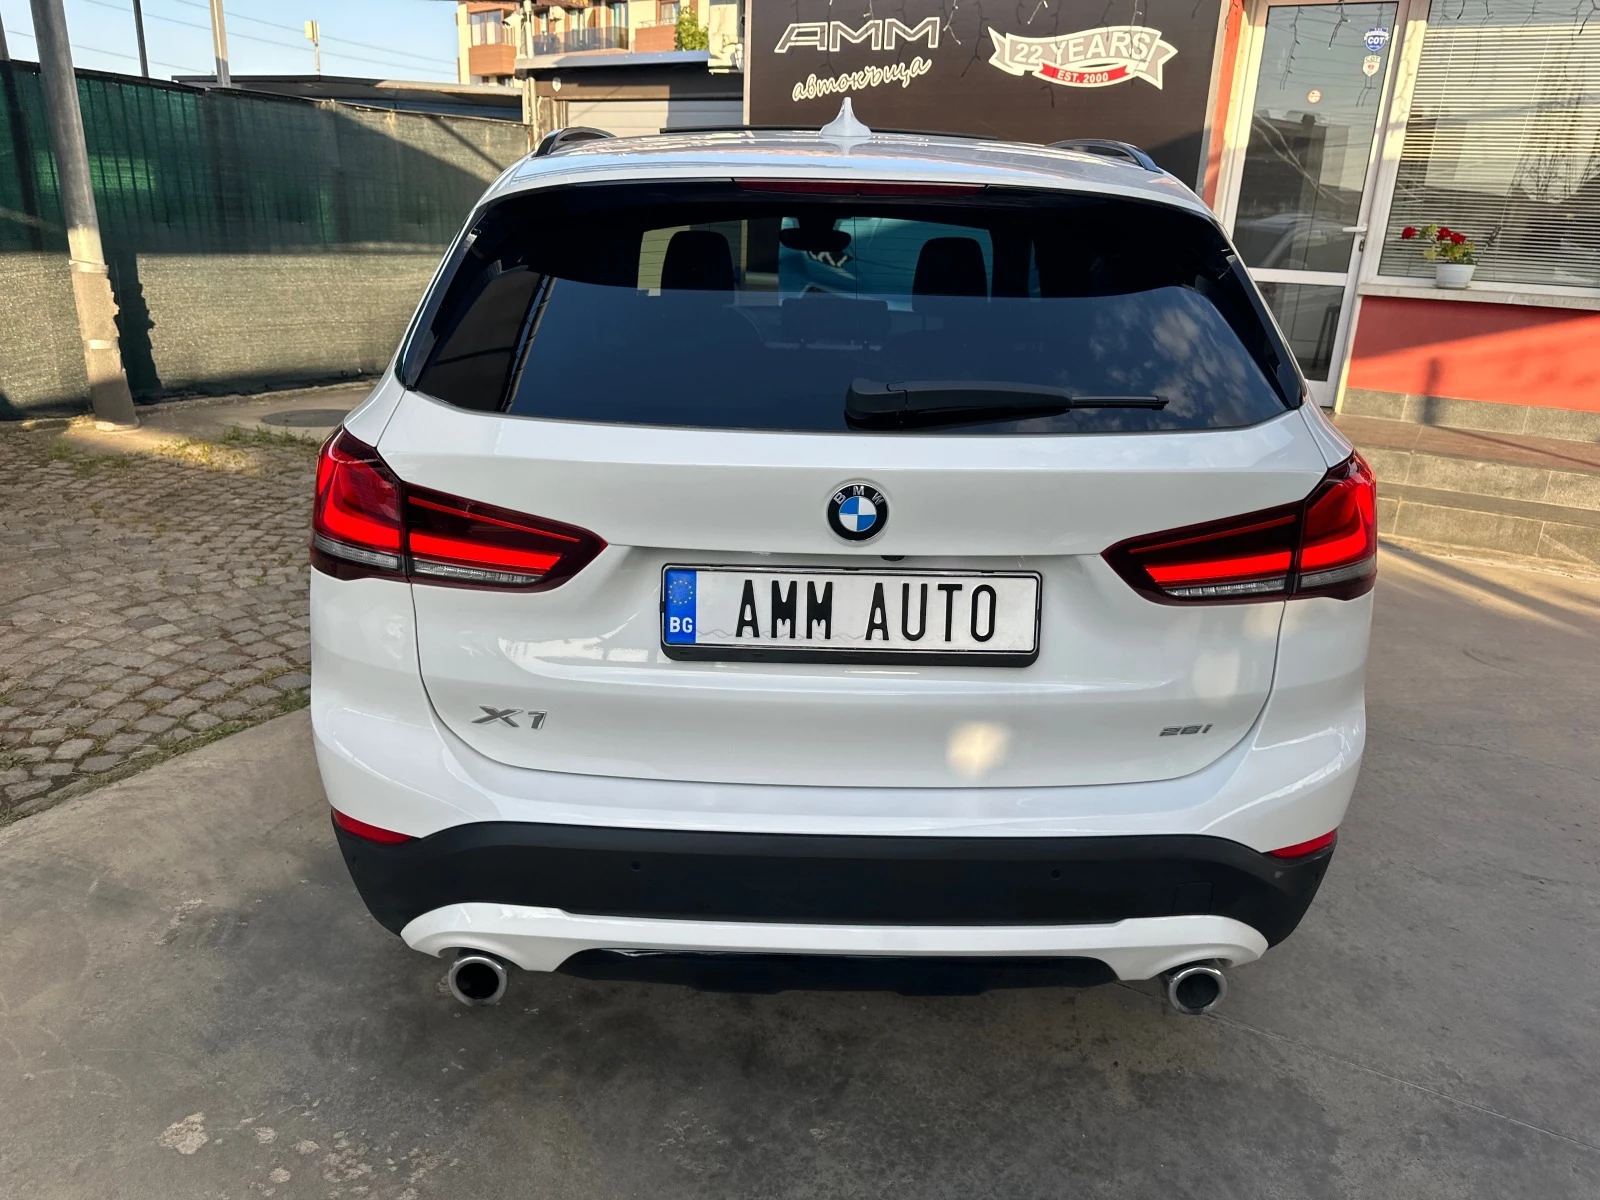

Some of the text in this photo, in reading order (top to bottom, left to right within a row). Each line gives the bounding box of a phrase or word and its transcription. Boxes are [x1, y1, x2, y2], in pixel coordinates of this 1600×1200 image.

[774, 16, 940, 53] AMM
[1013, 31, 1151, 66] 22 YEARS
[792, 56, 932, 102] автокъща
[1056, 69, 1109, 84] EST. 2000
[833, 485, 885, 506] BMW
[669, 616, 694, 634] BG
[735, 579, 998, 643] AMM AUTO
[471, 704, 548, 730] X1
